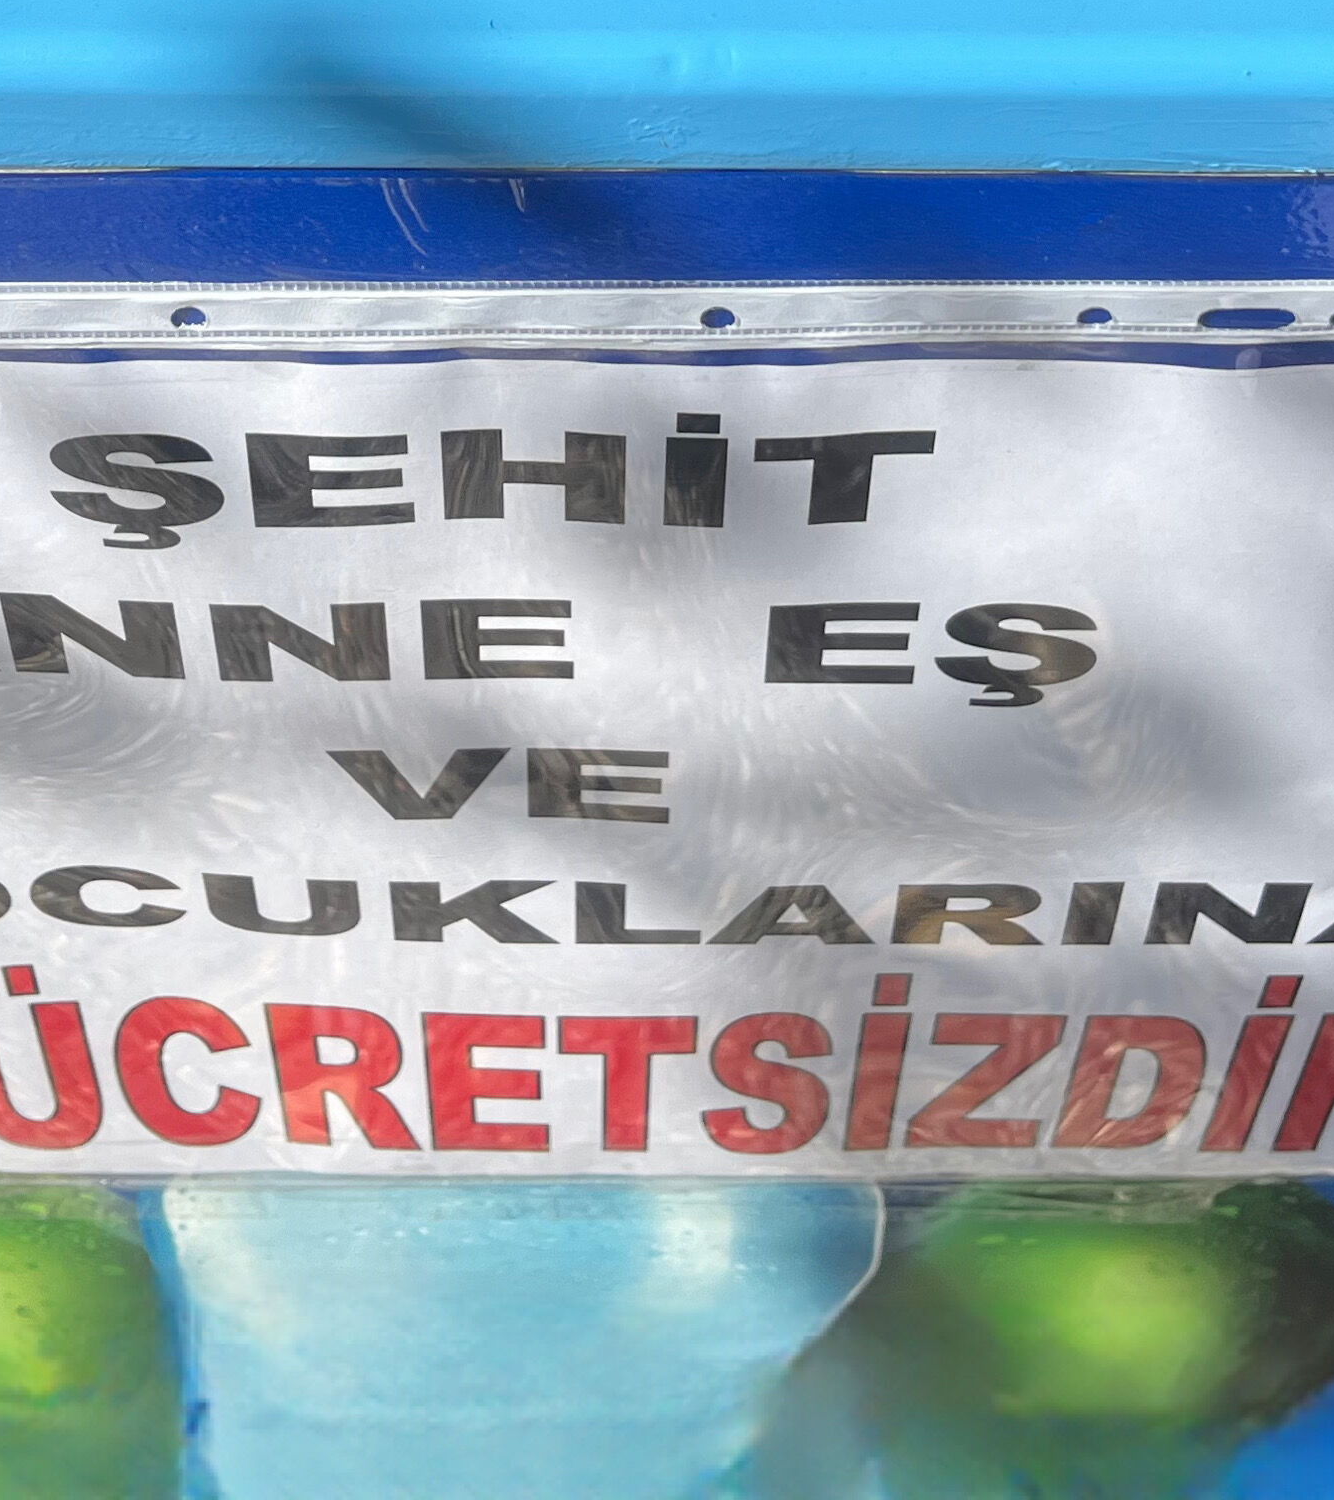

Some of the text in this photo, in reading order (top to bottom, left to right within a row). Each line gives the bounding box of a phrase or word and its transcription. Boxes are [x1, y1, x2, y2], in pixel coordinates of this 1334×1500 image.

[49, 411, 937, 550] ŞEHİT
[764, 602, 1098, 709] EŞ
[326, 747, 671, 825] VE
